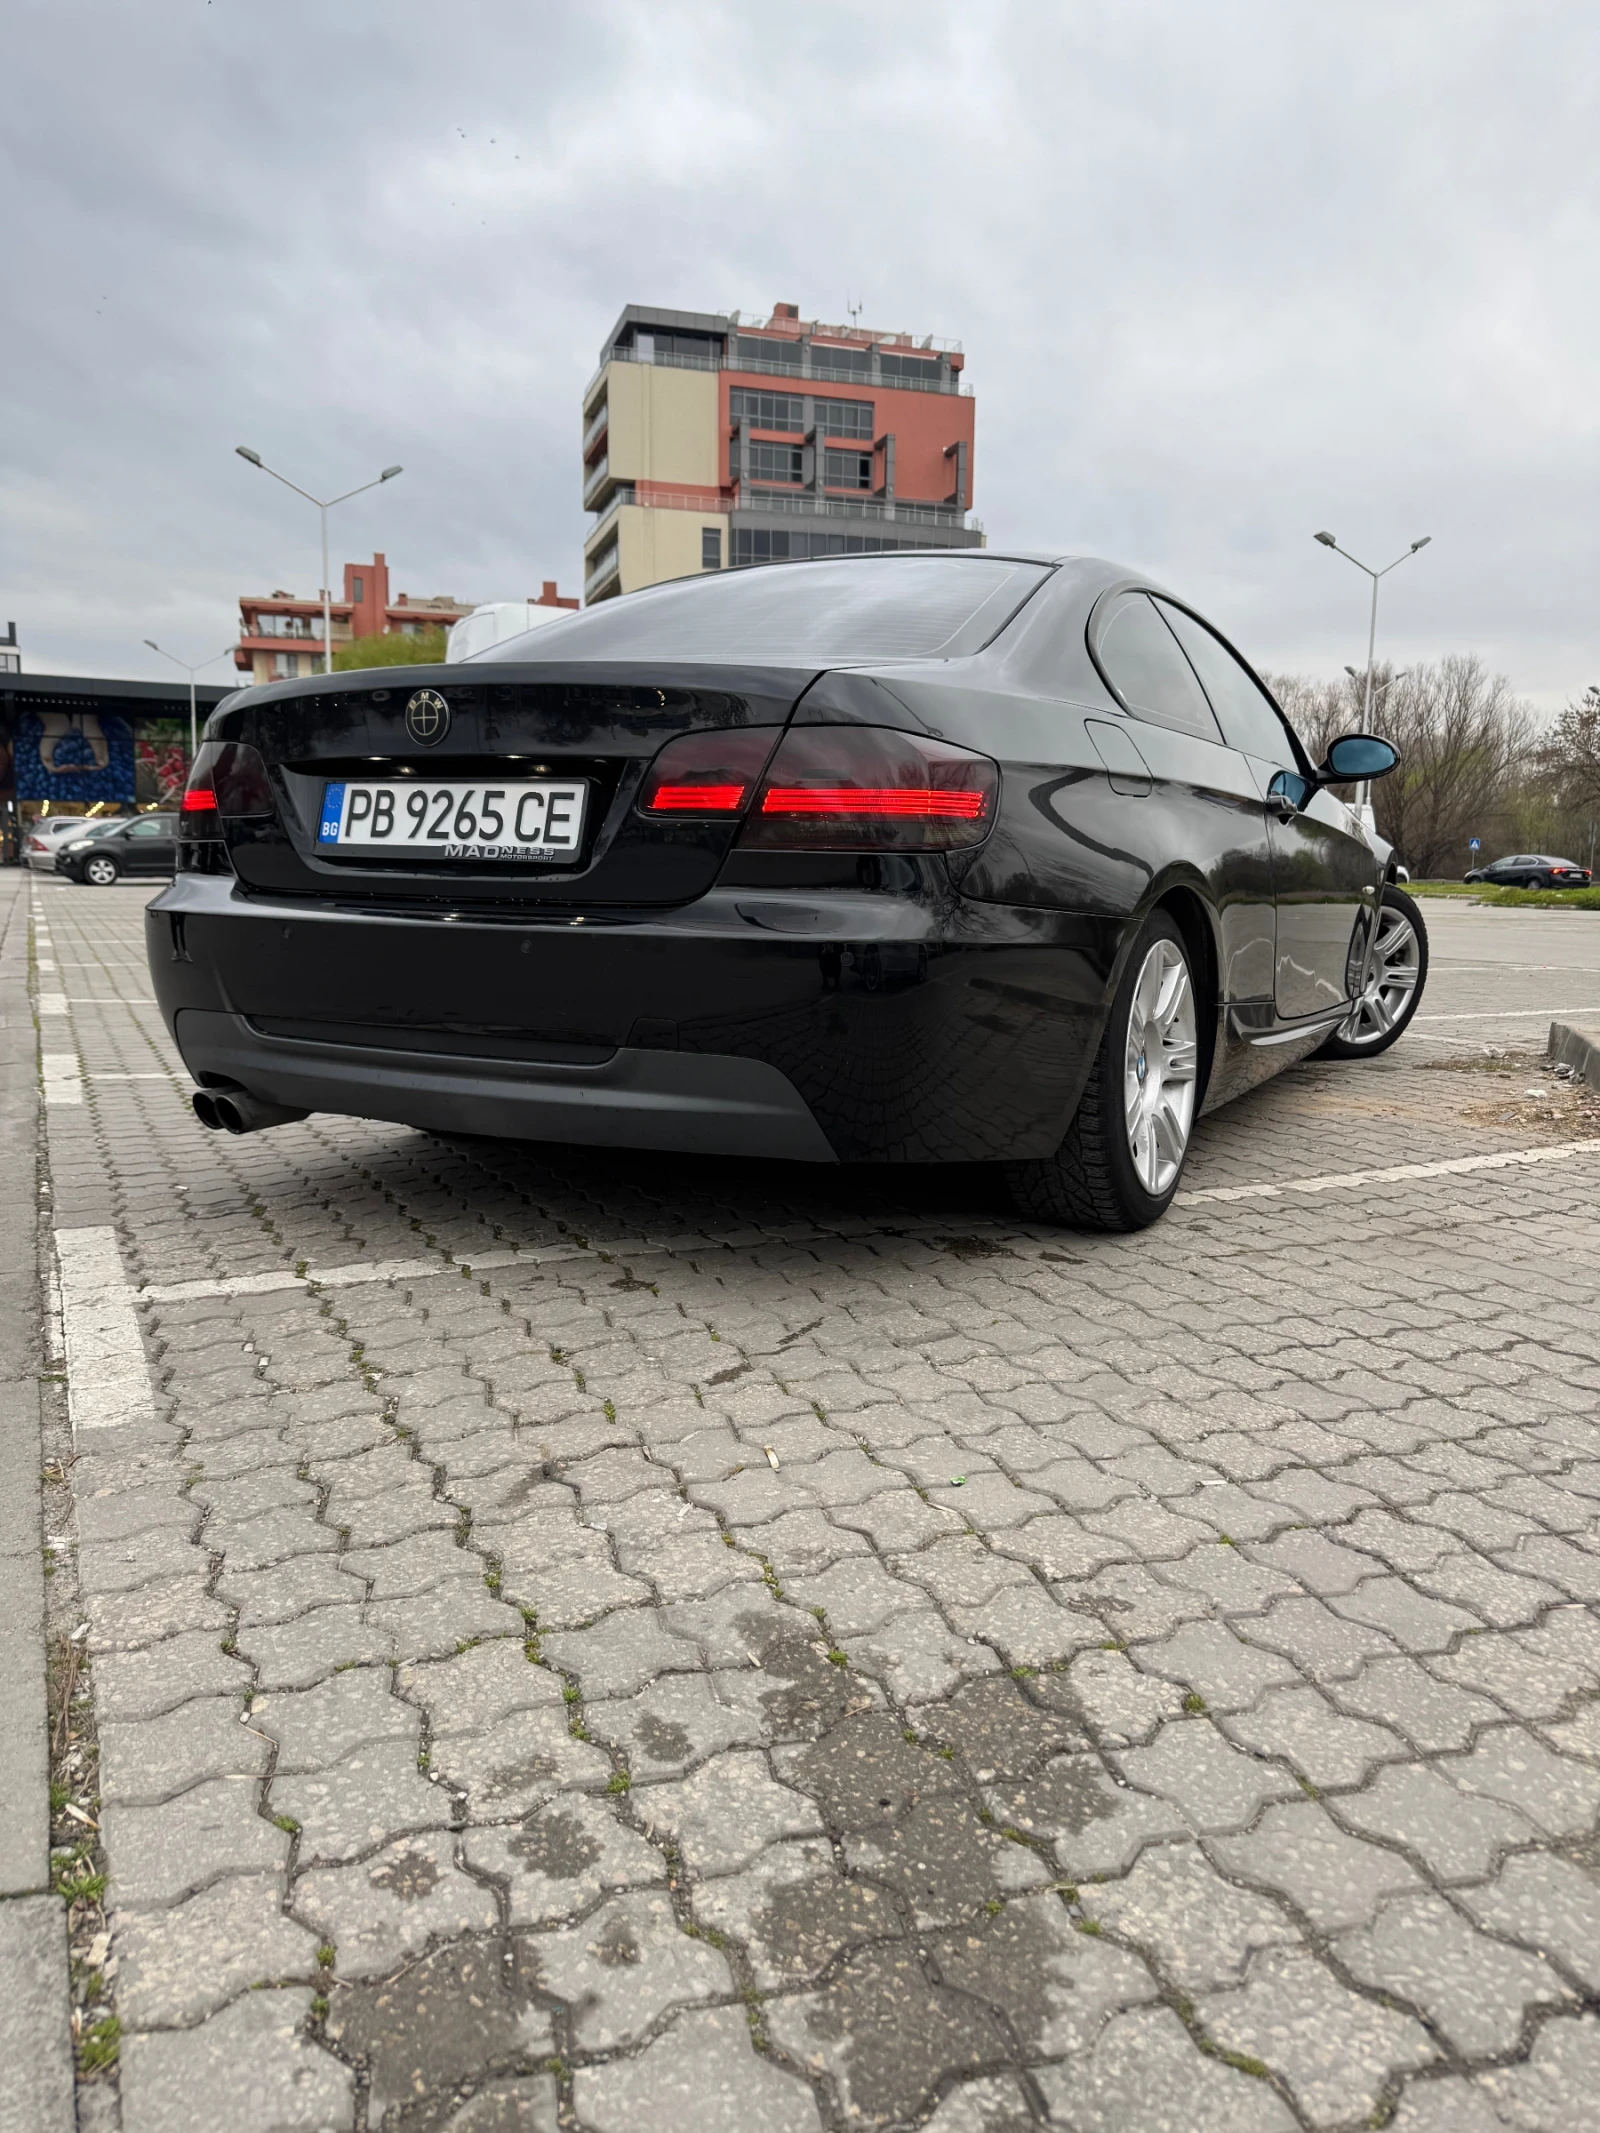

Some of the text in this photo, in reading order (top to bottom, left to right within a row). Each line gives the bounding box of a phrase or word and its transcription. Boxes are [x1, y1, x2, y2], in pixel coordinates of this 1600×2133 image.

[408, 691, 444, 710] BMW
[345, 789, 575, 844] PB 9265 CE
[322, 822, 339, 836] BG
[444, 843, 555, 859] MADNESS
[500, 853, 555, 862] MOTORSPORT
